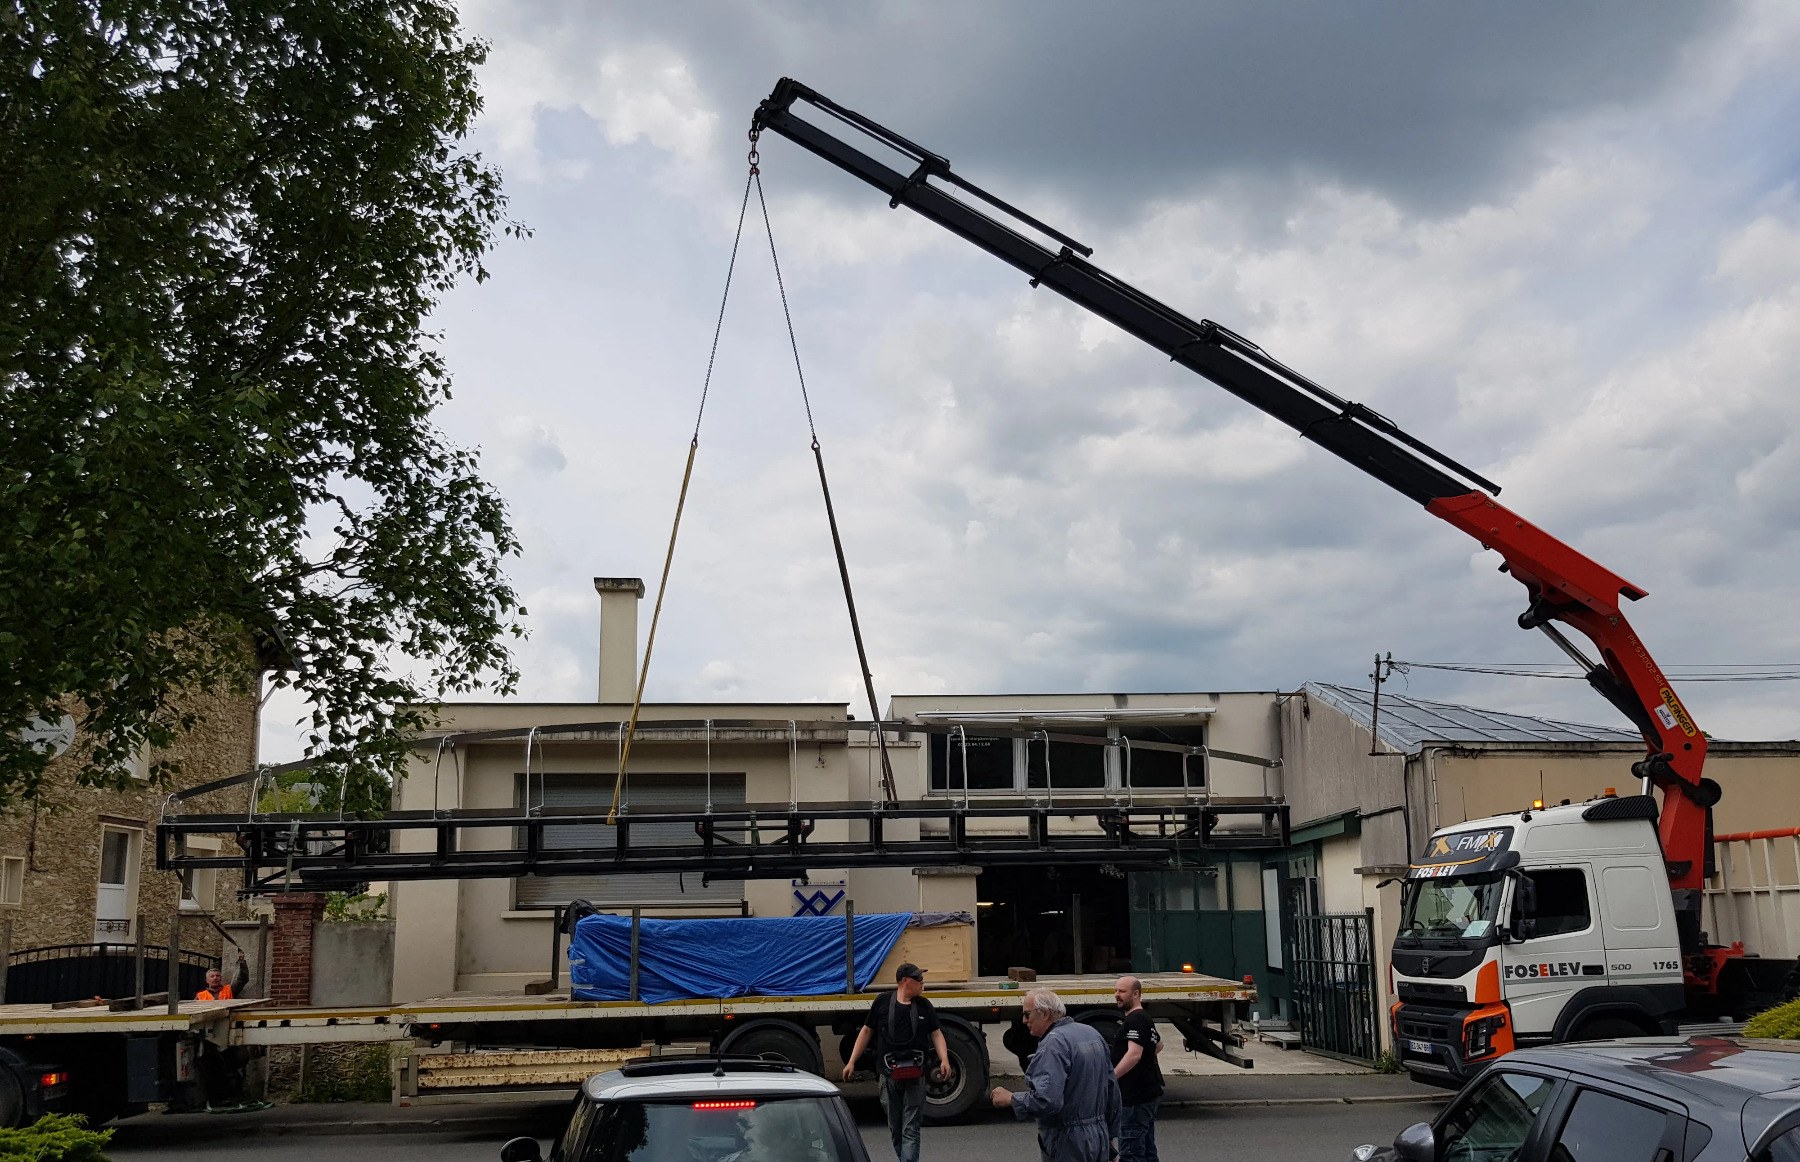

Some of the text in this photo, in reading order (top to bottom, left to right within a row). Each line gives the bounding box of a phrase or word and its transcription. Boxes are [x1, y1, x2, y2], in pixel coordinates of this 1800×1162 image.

[1627, 634, 1638, 646] PK
[1661, 689, 1694, 734] PALFINGER
[1415, 864, 1459, 878] FOSELEV
[1504, 961, 1679, 979] FOSELEV 500 1765
